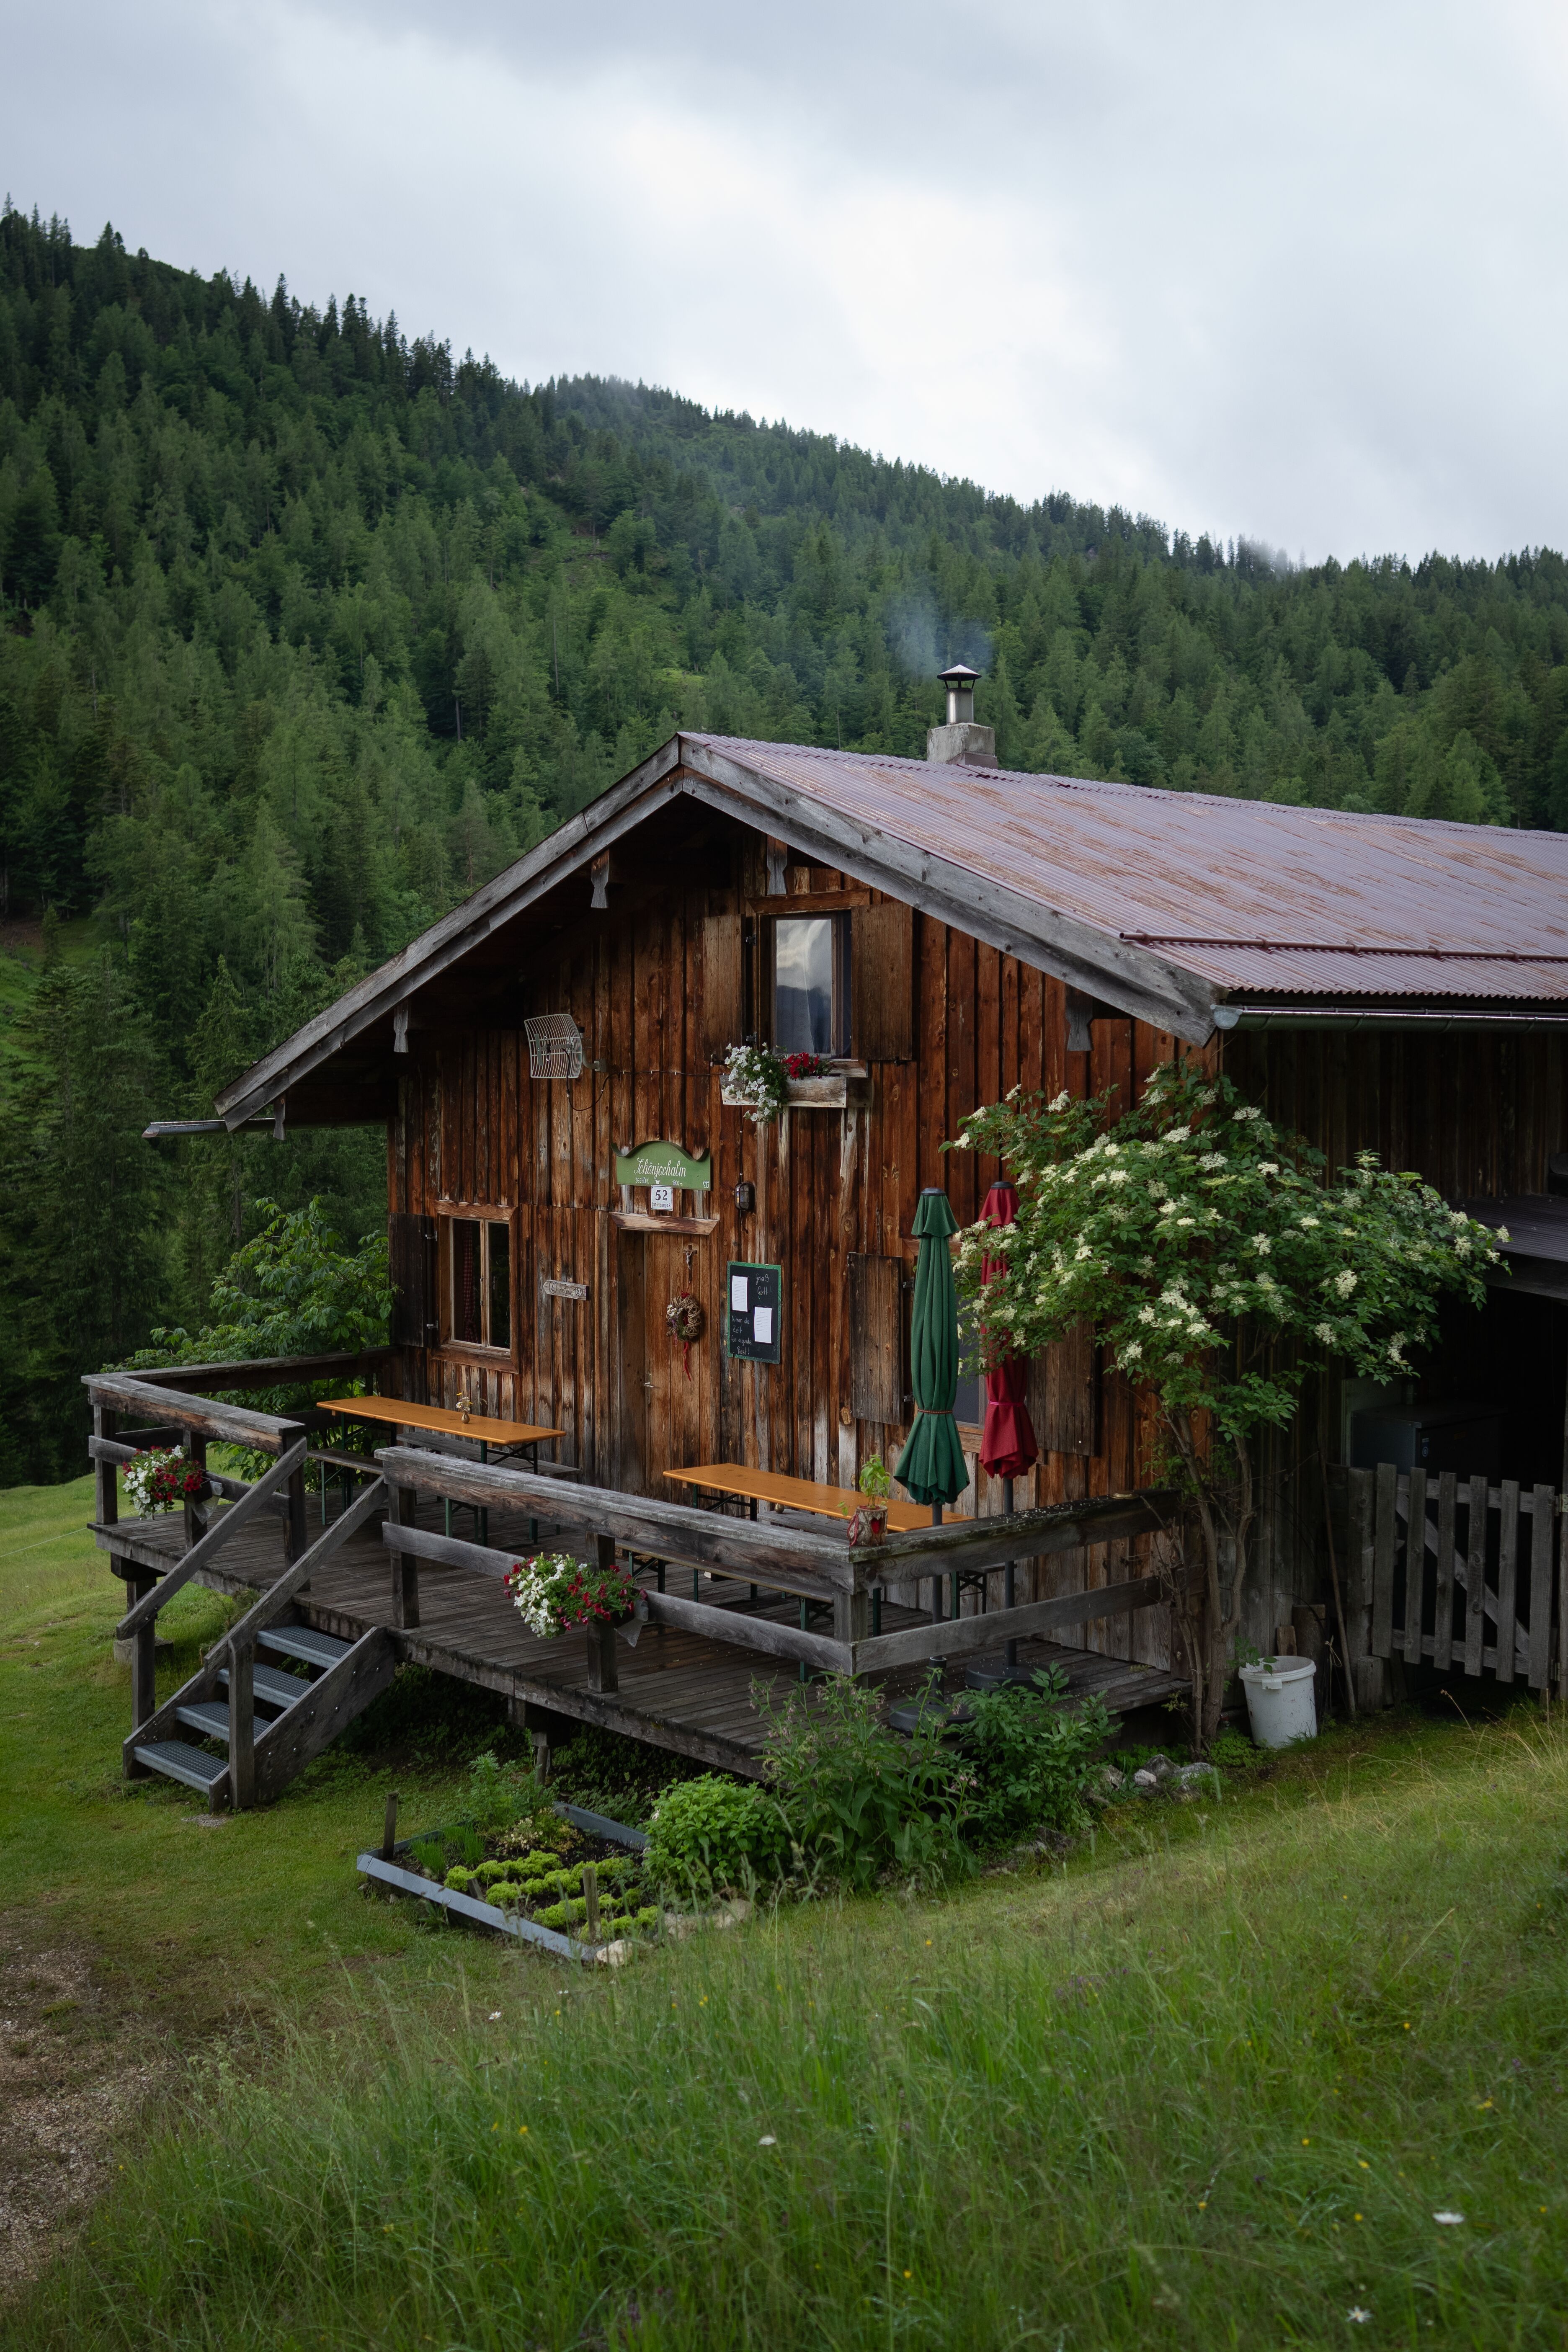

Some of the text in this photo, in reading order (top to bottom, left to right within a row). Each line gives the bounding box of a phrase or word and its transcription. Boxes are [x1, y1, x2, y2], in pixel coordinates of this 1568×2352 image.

[634, 1157, 686, 1179] Schönjochalm
[655, 1190, 668, 1201] 52
[559, 1285, 573, 1295] Retour
[732, 1325, 742, 1333] Zeit
